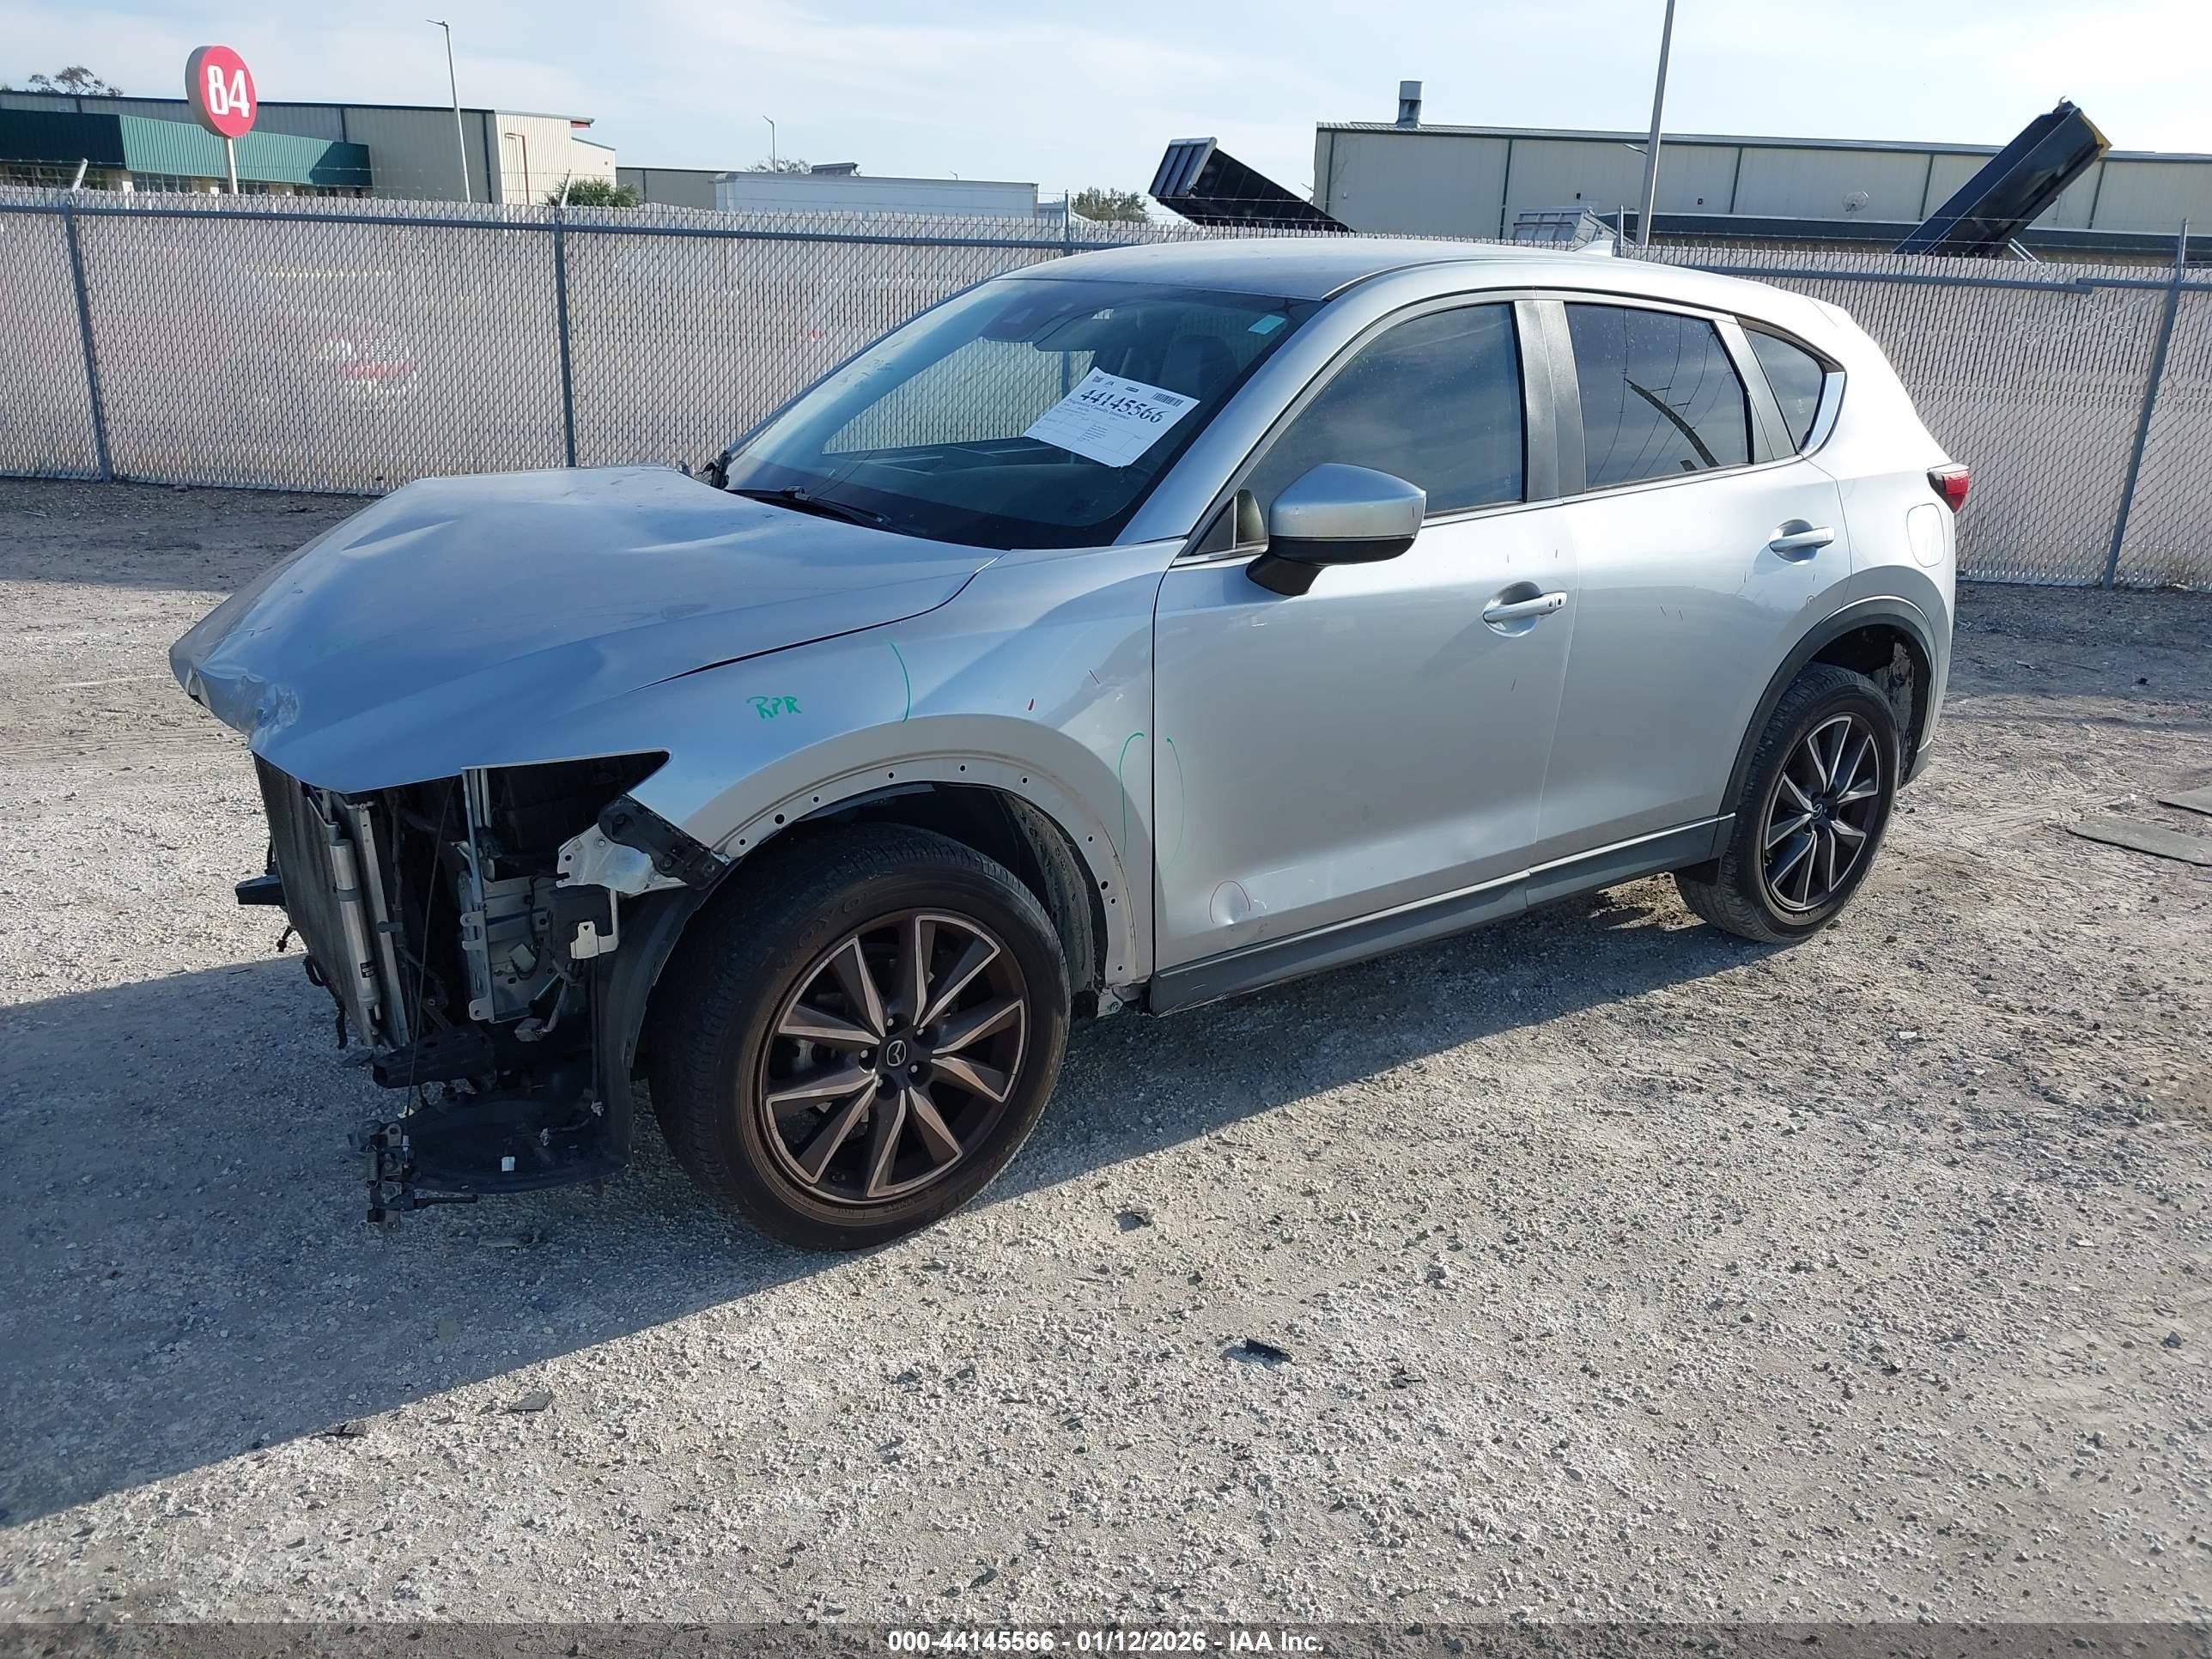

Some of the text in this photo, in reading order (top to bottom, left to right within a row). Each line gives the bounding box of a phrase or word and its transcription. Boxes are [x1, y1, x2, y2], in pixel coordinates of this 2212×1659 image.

[207, 64, 251, 118] 84
[1080, 389, 1170, 423] 44145566
[745, 696, 802, 720] RPR
